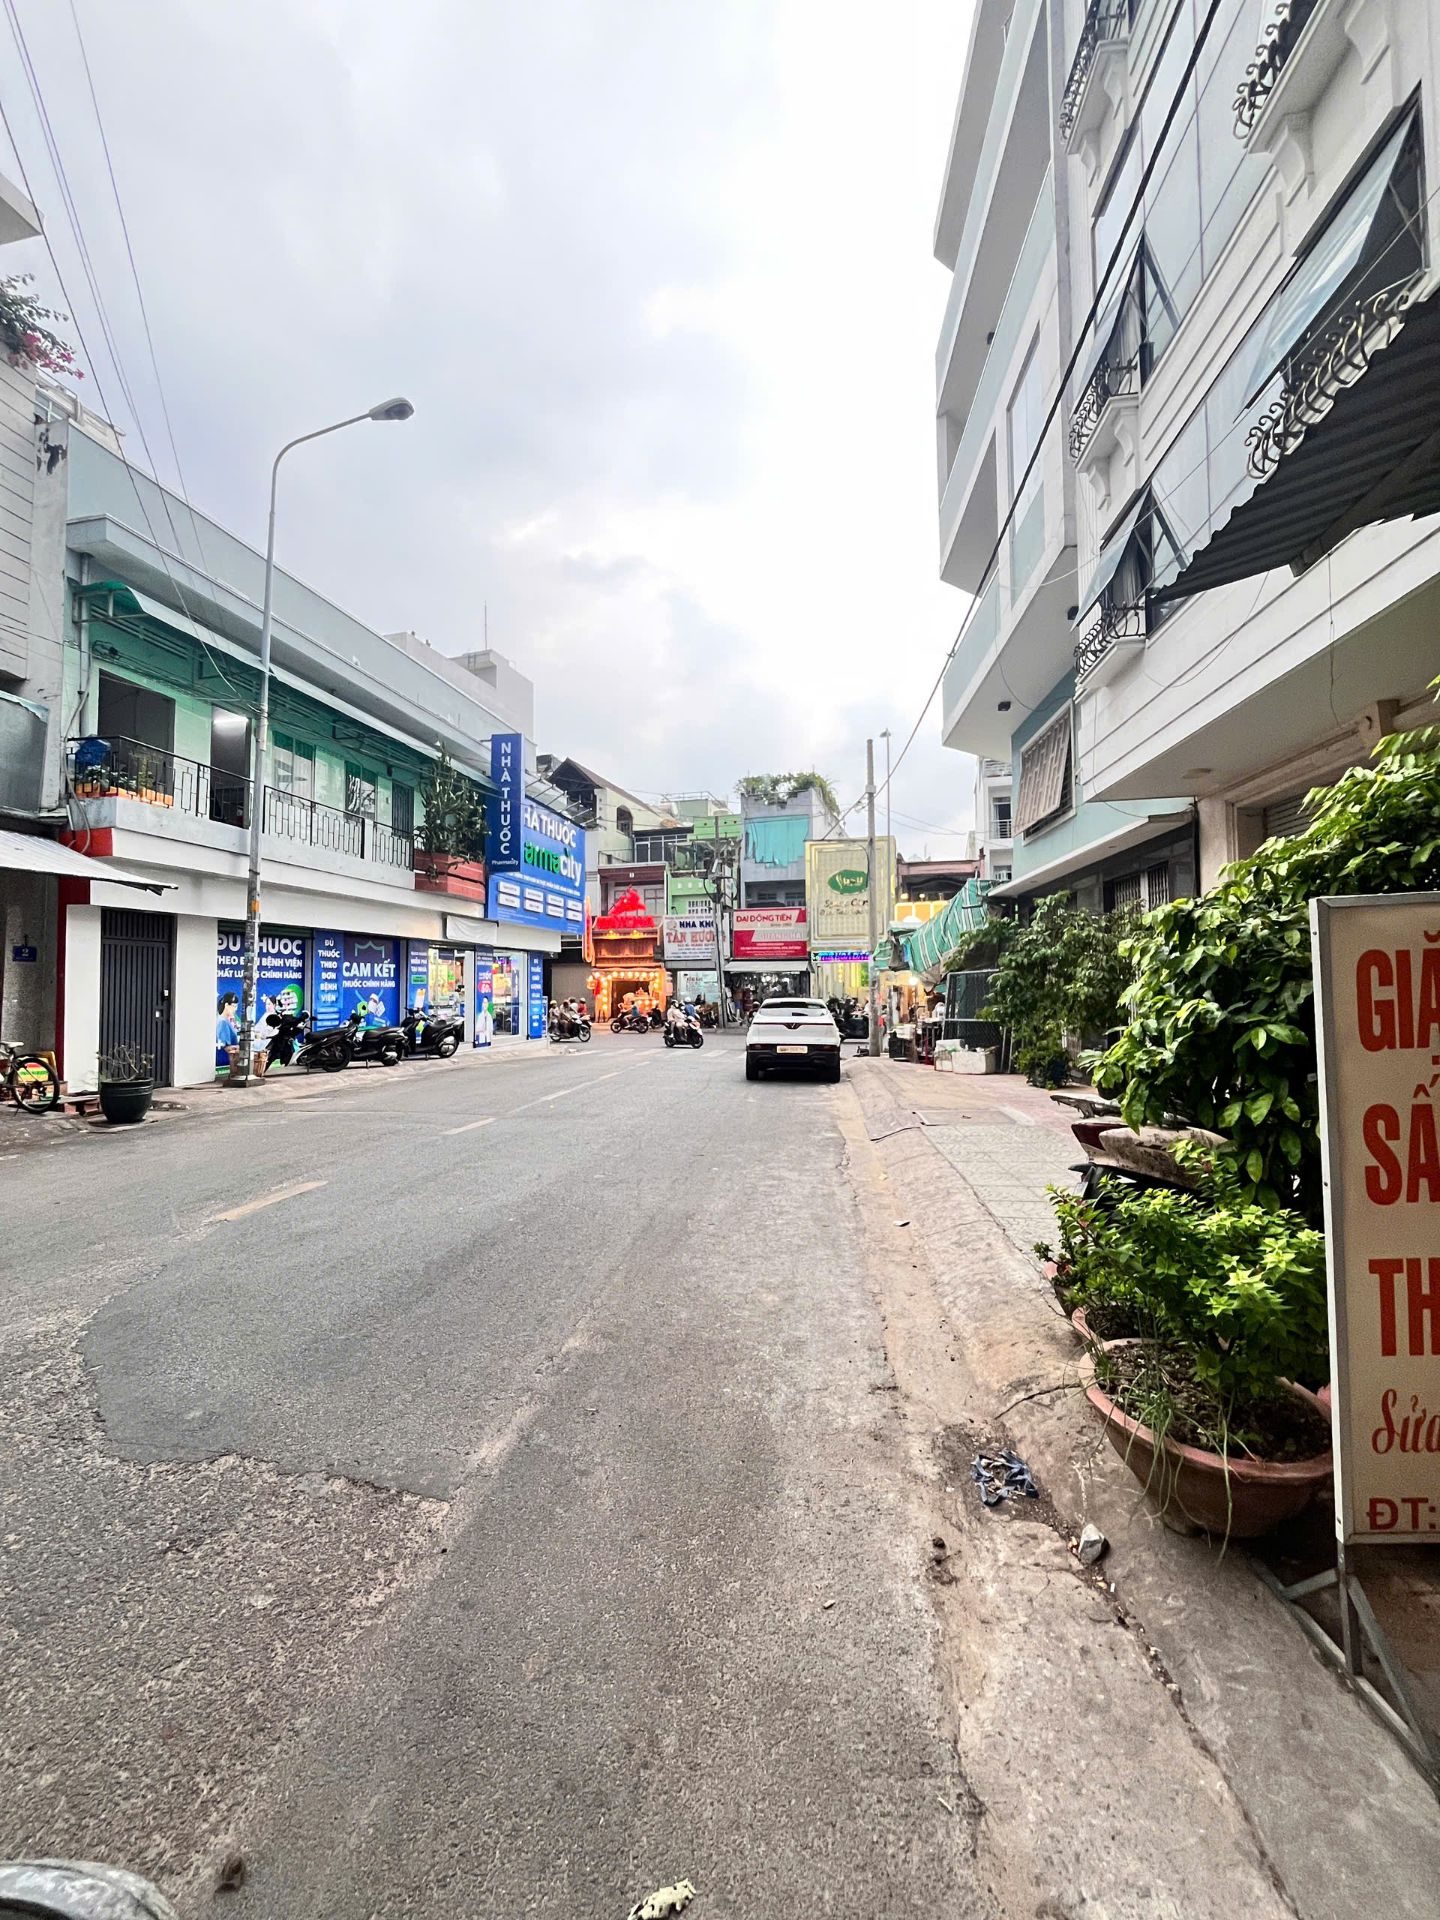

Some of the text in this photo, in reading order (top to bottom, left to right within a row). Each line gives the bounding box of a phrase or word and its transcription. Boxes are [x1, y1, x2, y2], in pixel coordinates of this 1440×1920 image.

[540, 816, 576, 848] THUỐC
[491, 857, 519, 866] Pharmacity
[679, 920, 697, 928] NHA
[318, 948, 340, 958] THUỐC
[262, 957, 284, 969] BỆNH
[285, 958, 303, 971] VIỆN
[320, 961, 338, 969] THEO
[342, 958, 395, 978] CAM KẾT
[261, 970, 283, 979] CHÍNH
[320, 982, 337, 993] BỆNH
[343, 977, 362, 988] THUỐC
[362, 978, 380, 988] CHÍNH
[321, 993, 336, 1004] VIỆN
[1366, 1497, 1437, 1531] ĐT:
